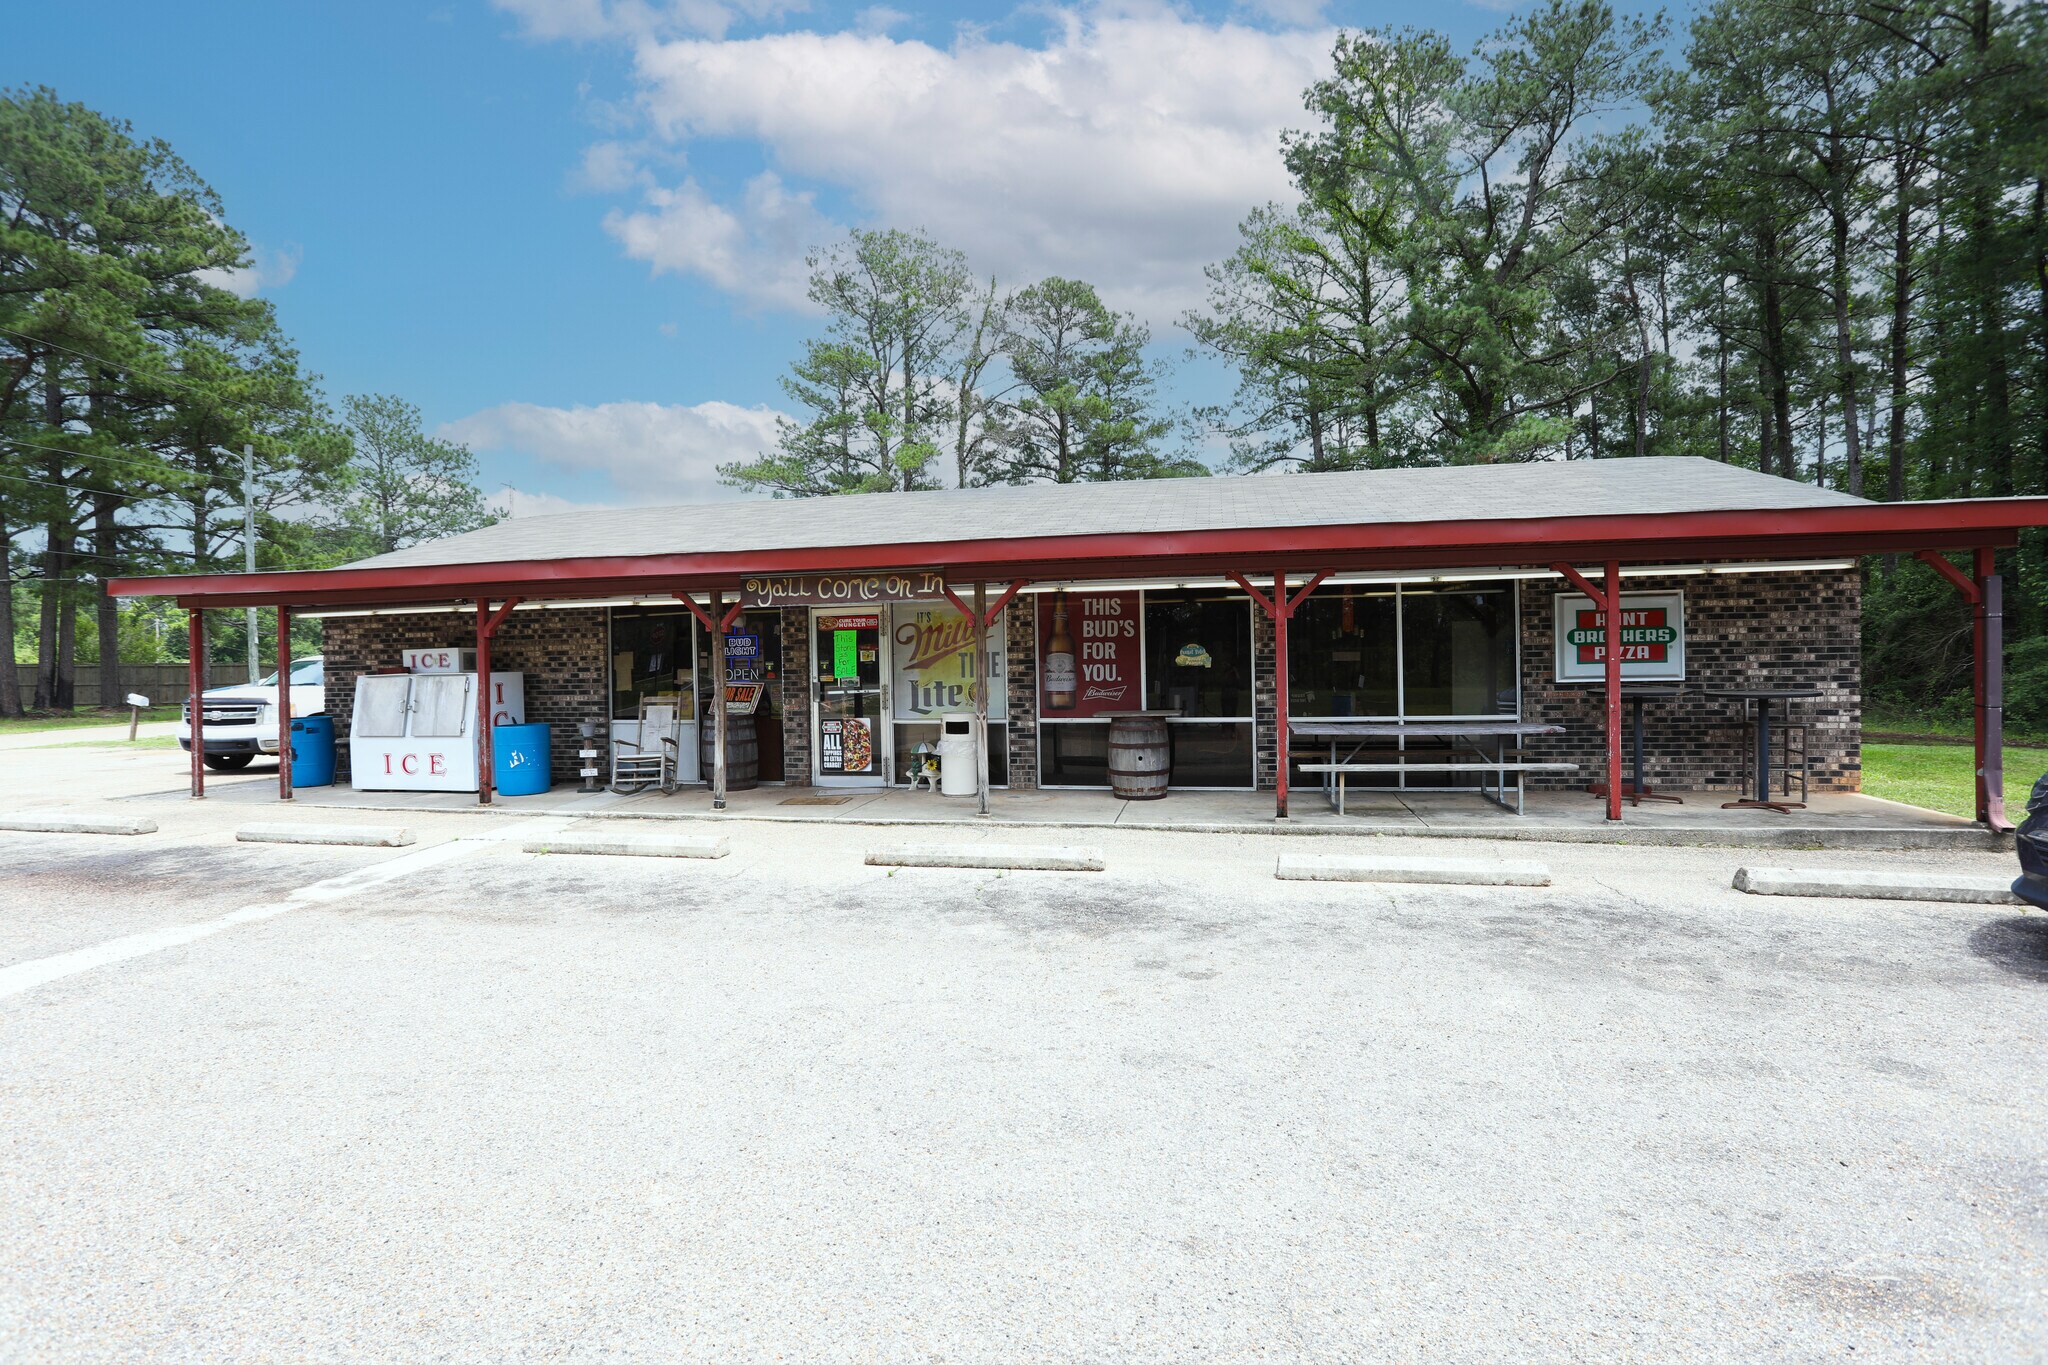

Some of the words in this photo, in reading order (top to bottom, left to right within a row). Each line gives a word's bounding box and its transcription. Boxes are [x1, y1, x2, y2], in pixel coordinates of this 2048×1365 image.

[917, 572, 945, 594] In
[1082, 598, 1121, 616] THIS
[916, 611, 931, 623] IT'S
[1595, 612, 1648, 627] HNT
[1082, 620, 1135, 638] BUD'S
[729, 638, 751, 646] BUD
[835, 634, 854, 643] This
[896, 619, 1000, 662] Mill
[724, 647, 756, 655] LIGHT
[1083, 642, 1116, 660] FOR
[1594, 646, 1649, 660] PZZA
[410, 653, 451, 669] ICE
[958, 652, 1001, 678] TIE
[725, 669, 759, 680] OPEN
[1082, 664, 1122, 681] YOU.
[735, 687, 754, 701] SALE
[908, 680, 963, 715] Lite
[1088, 689, 1122, 697] Budweiser
[823, 735, 842, 750] ALL
[383, 752, 447, 777] ICE
